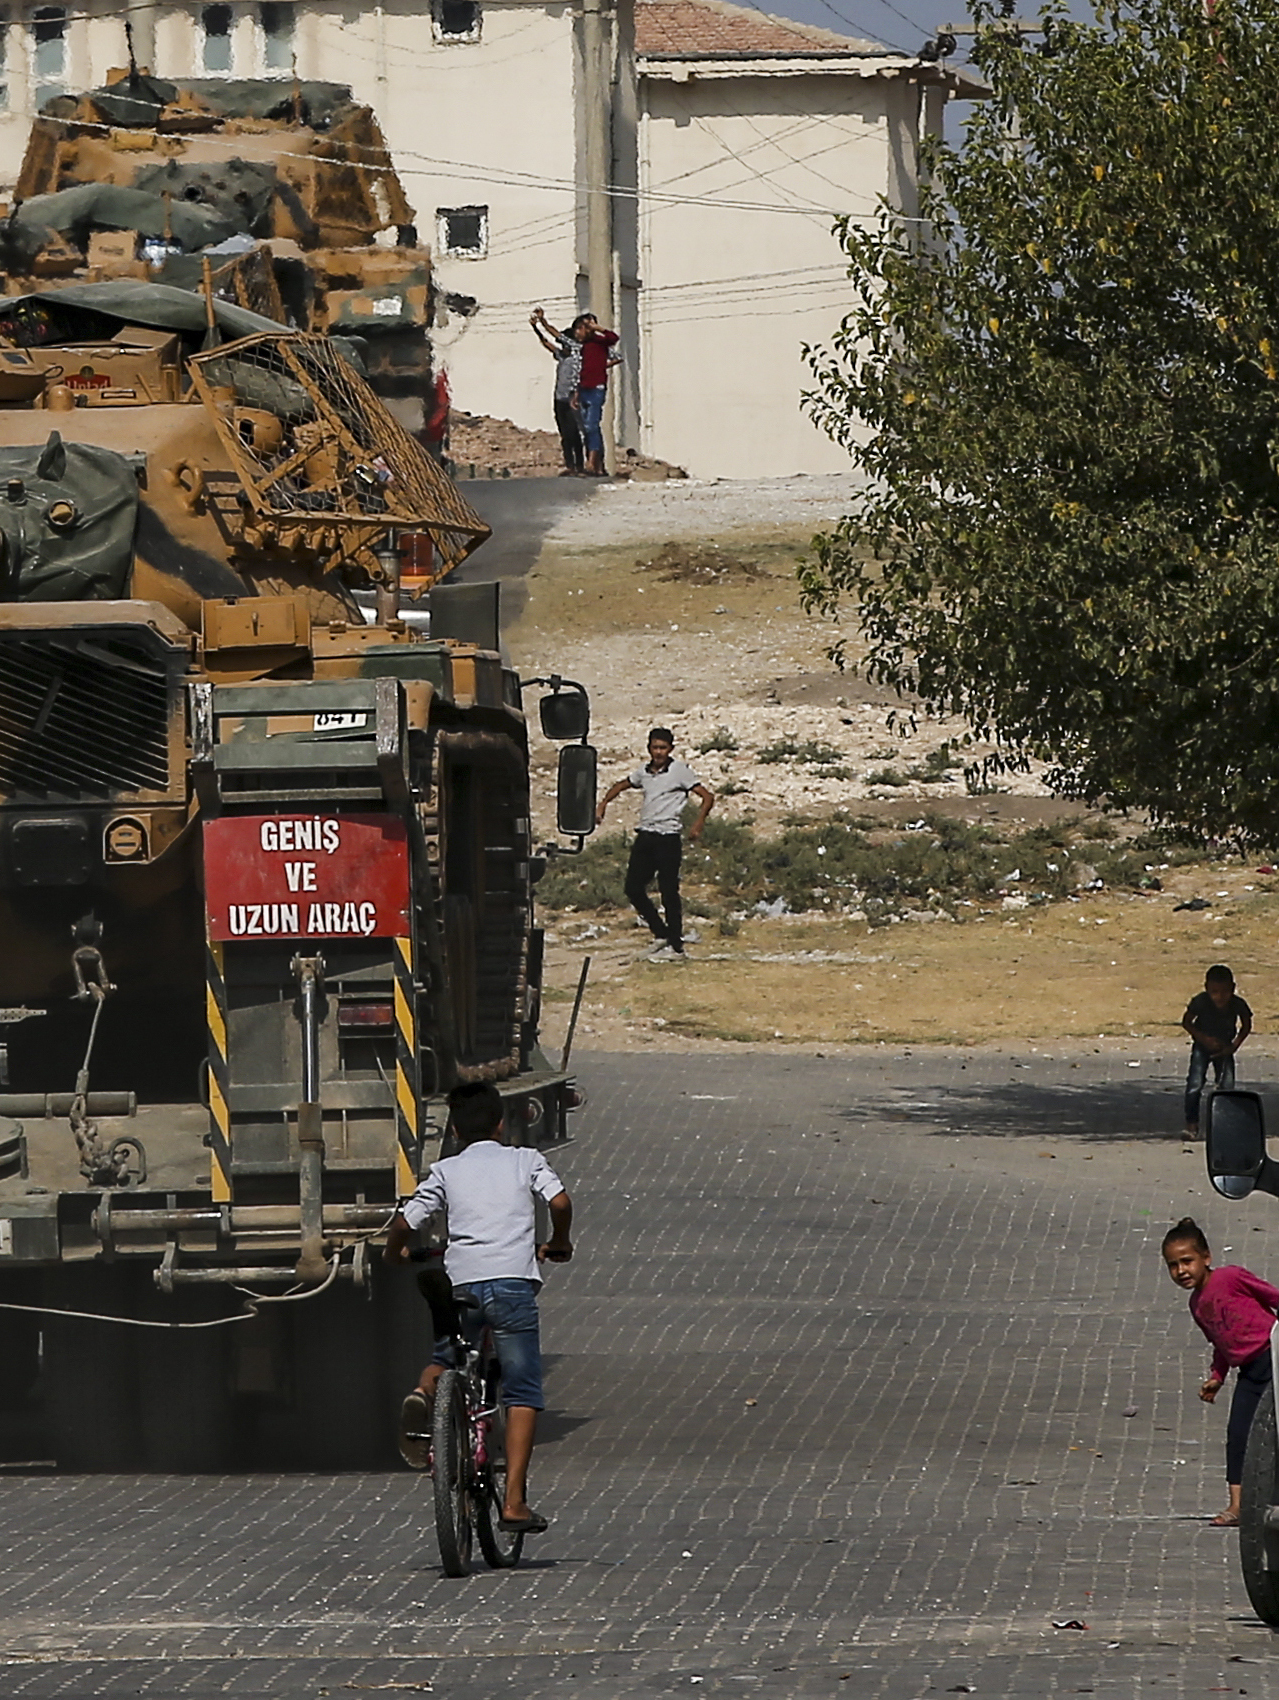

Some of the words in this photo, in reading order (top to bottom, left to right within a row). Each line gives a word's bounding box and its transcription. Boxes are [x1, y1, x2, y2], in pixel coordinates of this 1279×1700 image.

[261, 815, 340, 854] GENİŞ
[284, 862, 318, 891] VE
[229, 905, 299, 935] UZUN
[307, 902, 376, 936] ARAÇ
